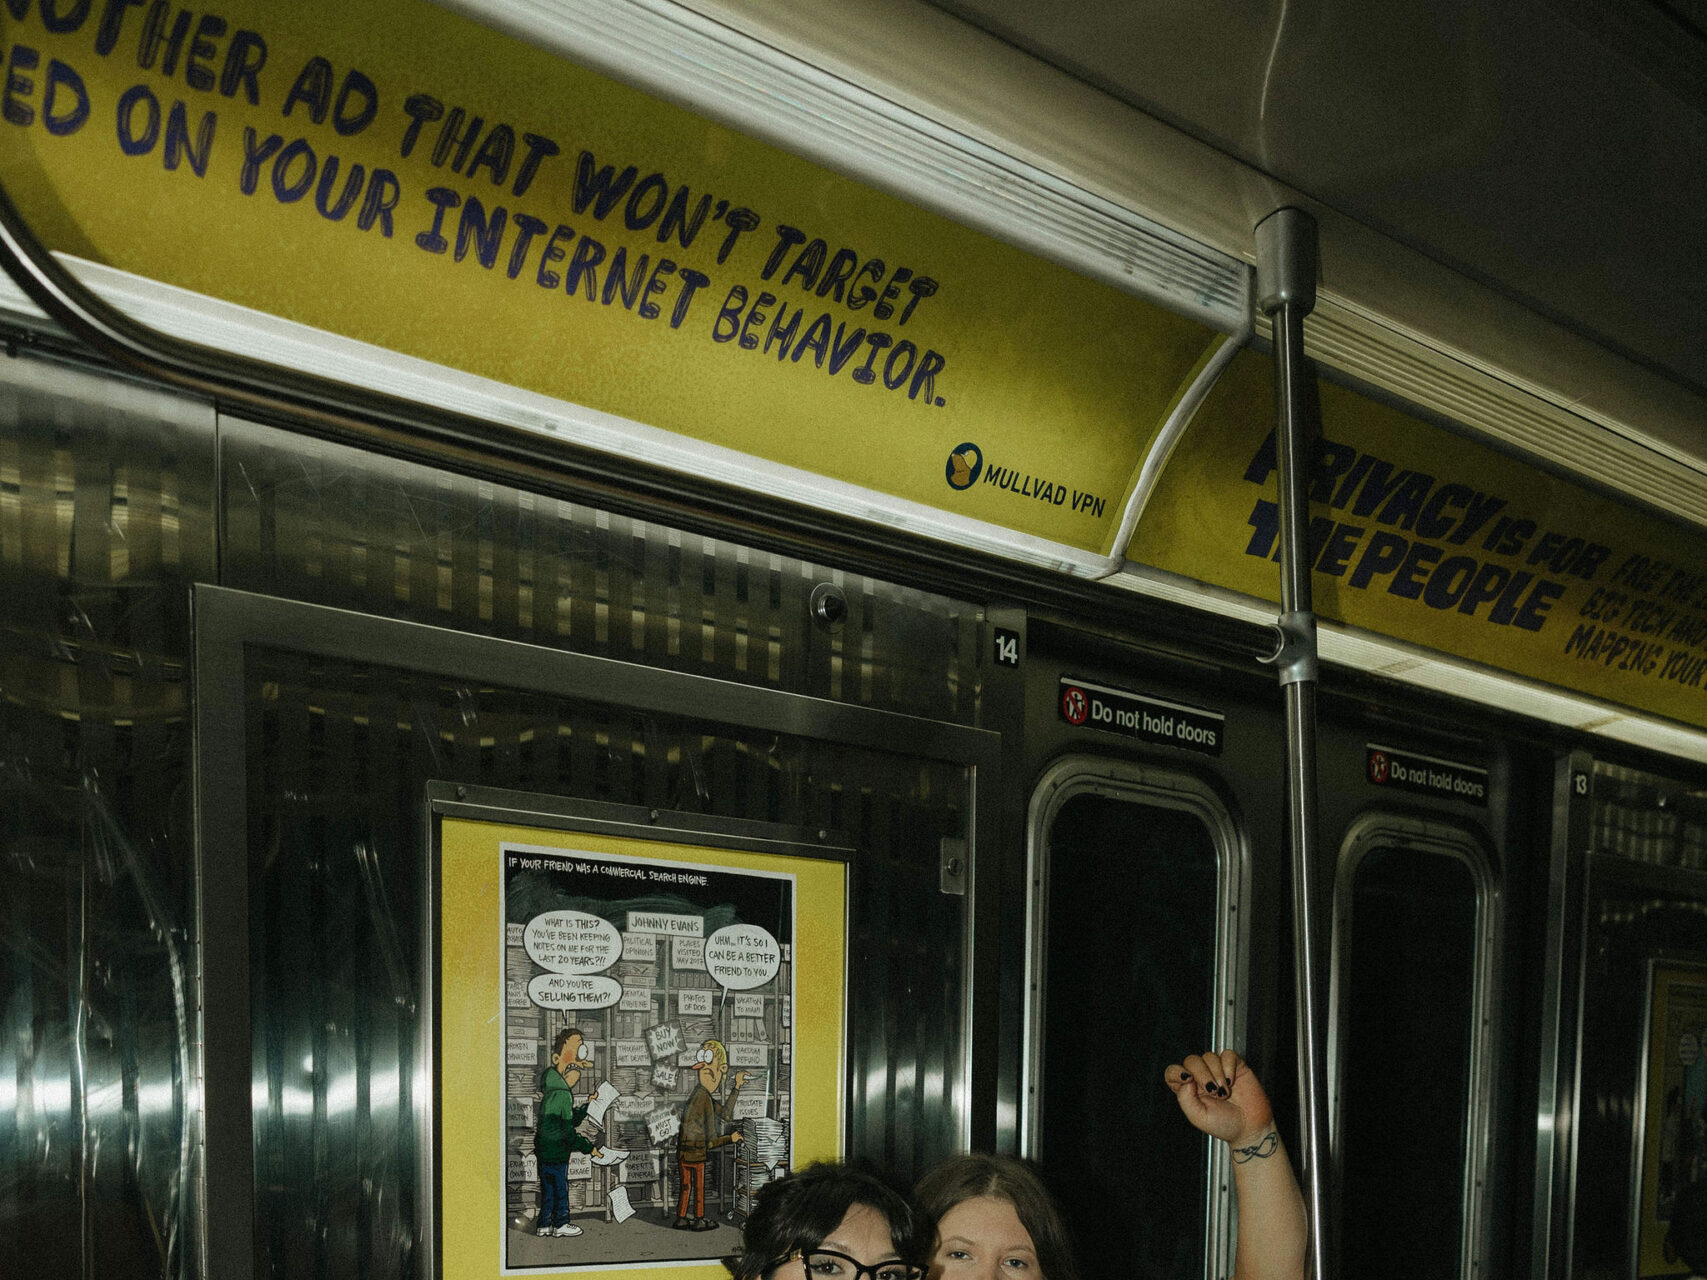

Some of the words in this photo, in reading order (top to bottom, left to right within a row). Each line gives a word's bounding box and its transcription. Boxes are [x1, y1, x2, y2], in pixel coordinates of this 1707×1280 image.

[283, 56, 379, 137] AD
[400, 94, 561, 197] THAT
[571, 151, 760, 265] WON'T
[761, 224, 939, 325] TARGET
[0, 44, 91, 137] ED
[116, 84, 218, 178] ON
[240, 126, 401, 239] YOUR
[415, 187, 711, 329] INTERNET
[712, 285, 947, 408] BEHAVIOR.
[983, 463, 1067, 507] MULLVAD
[1071, 487, 1107, 519] VPN
[1483, 516, 1538, 556] IS
[1525, 531, 1611, 580] FOR
[1348, 530, 1566, 633] PEOPLE
[996, 635, 1018, 665] 14
[1564, 623, 1664, 675] MAPPING
[1092, 700, 1113, 723] Do
[1116, 709, 1140, 729] not
[1143, 715, 1173, 737] hold
[1177, 721, 1217, 746] doors
[1391, 761, 1408, 780] Do
[1409, 769, 1427, 785] not
[1429, 774, 1452, 790] hold
[1454, 776, 1485, 797] doors
[1575, 774, 1588, 795] 13
[508, 856, 517, 868] IF
[520, 858, 541, 870] YOUR
[544, 860, 573, 873] FRIEND
[575, 863, 591, 875] WAS
[592, 864, 599, 874] A
[600, 865, 647, 880] COMMERCIAL
[649, 870, 677, 883] SEARCH
[544, 918, 563, 928] WHAT
[565, 919, 574, 928] IS
[574, 919, 600, 931] THIS?
[631, 916, 668, 931] JOHNNY
[670, 918, 699, 932] EVANS
[532, 929, 556, 940] YOU'VE
[558, 930, 578, 941] BEEN
[580, 932, 611, 942] KEEPING
[737, 934, 752, 946] IT'S
[753, 938, 764, 947] SO
[533, 942, 556, 952] NOTES
[556, 943, 567, 952] ON
[568, 945, 579, 953] ME
[580, 945, 594, 954] FOR
[595, 945, 610, 954] THE
[538, 954, 556, 963] LAST
[558, 955, 569, 963] 20
[708, 950, 725, 960] CAN
[726, 950, 737, 961] BE
[738, 951, 745, 961] A
[746, 952, 776, 964] BETTER
[714, 965, 742, 977] FRIEND
[744, 967, 754, 977] TO
[548, 978, 565, 988] AND
[567, 979, 594, 989] YOU'RE
[538, 991, 577, 1002] SELLING
[577, 992, 611, 1003] THEM?!
[684, 1004, 692, 1012] OF
[655, 1027, 671, 1041] BUY
[656, 1037, 679, 1053] NOW!
